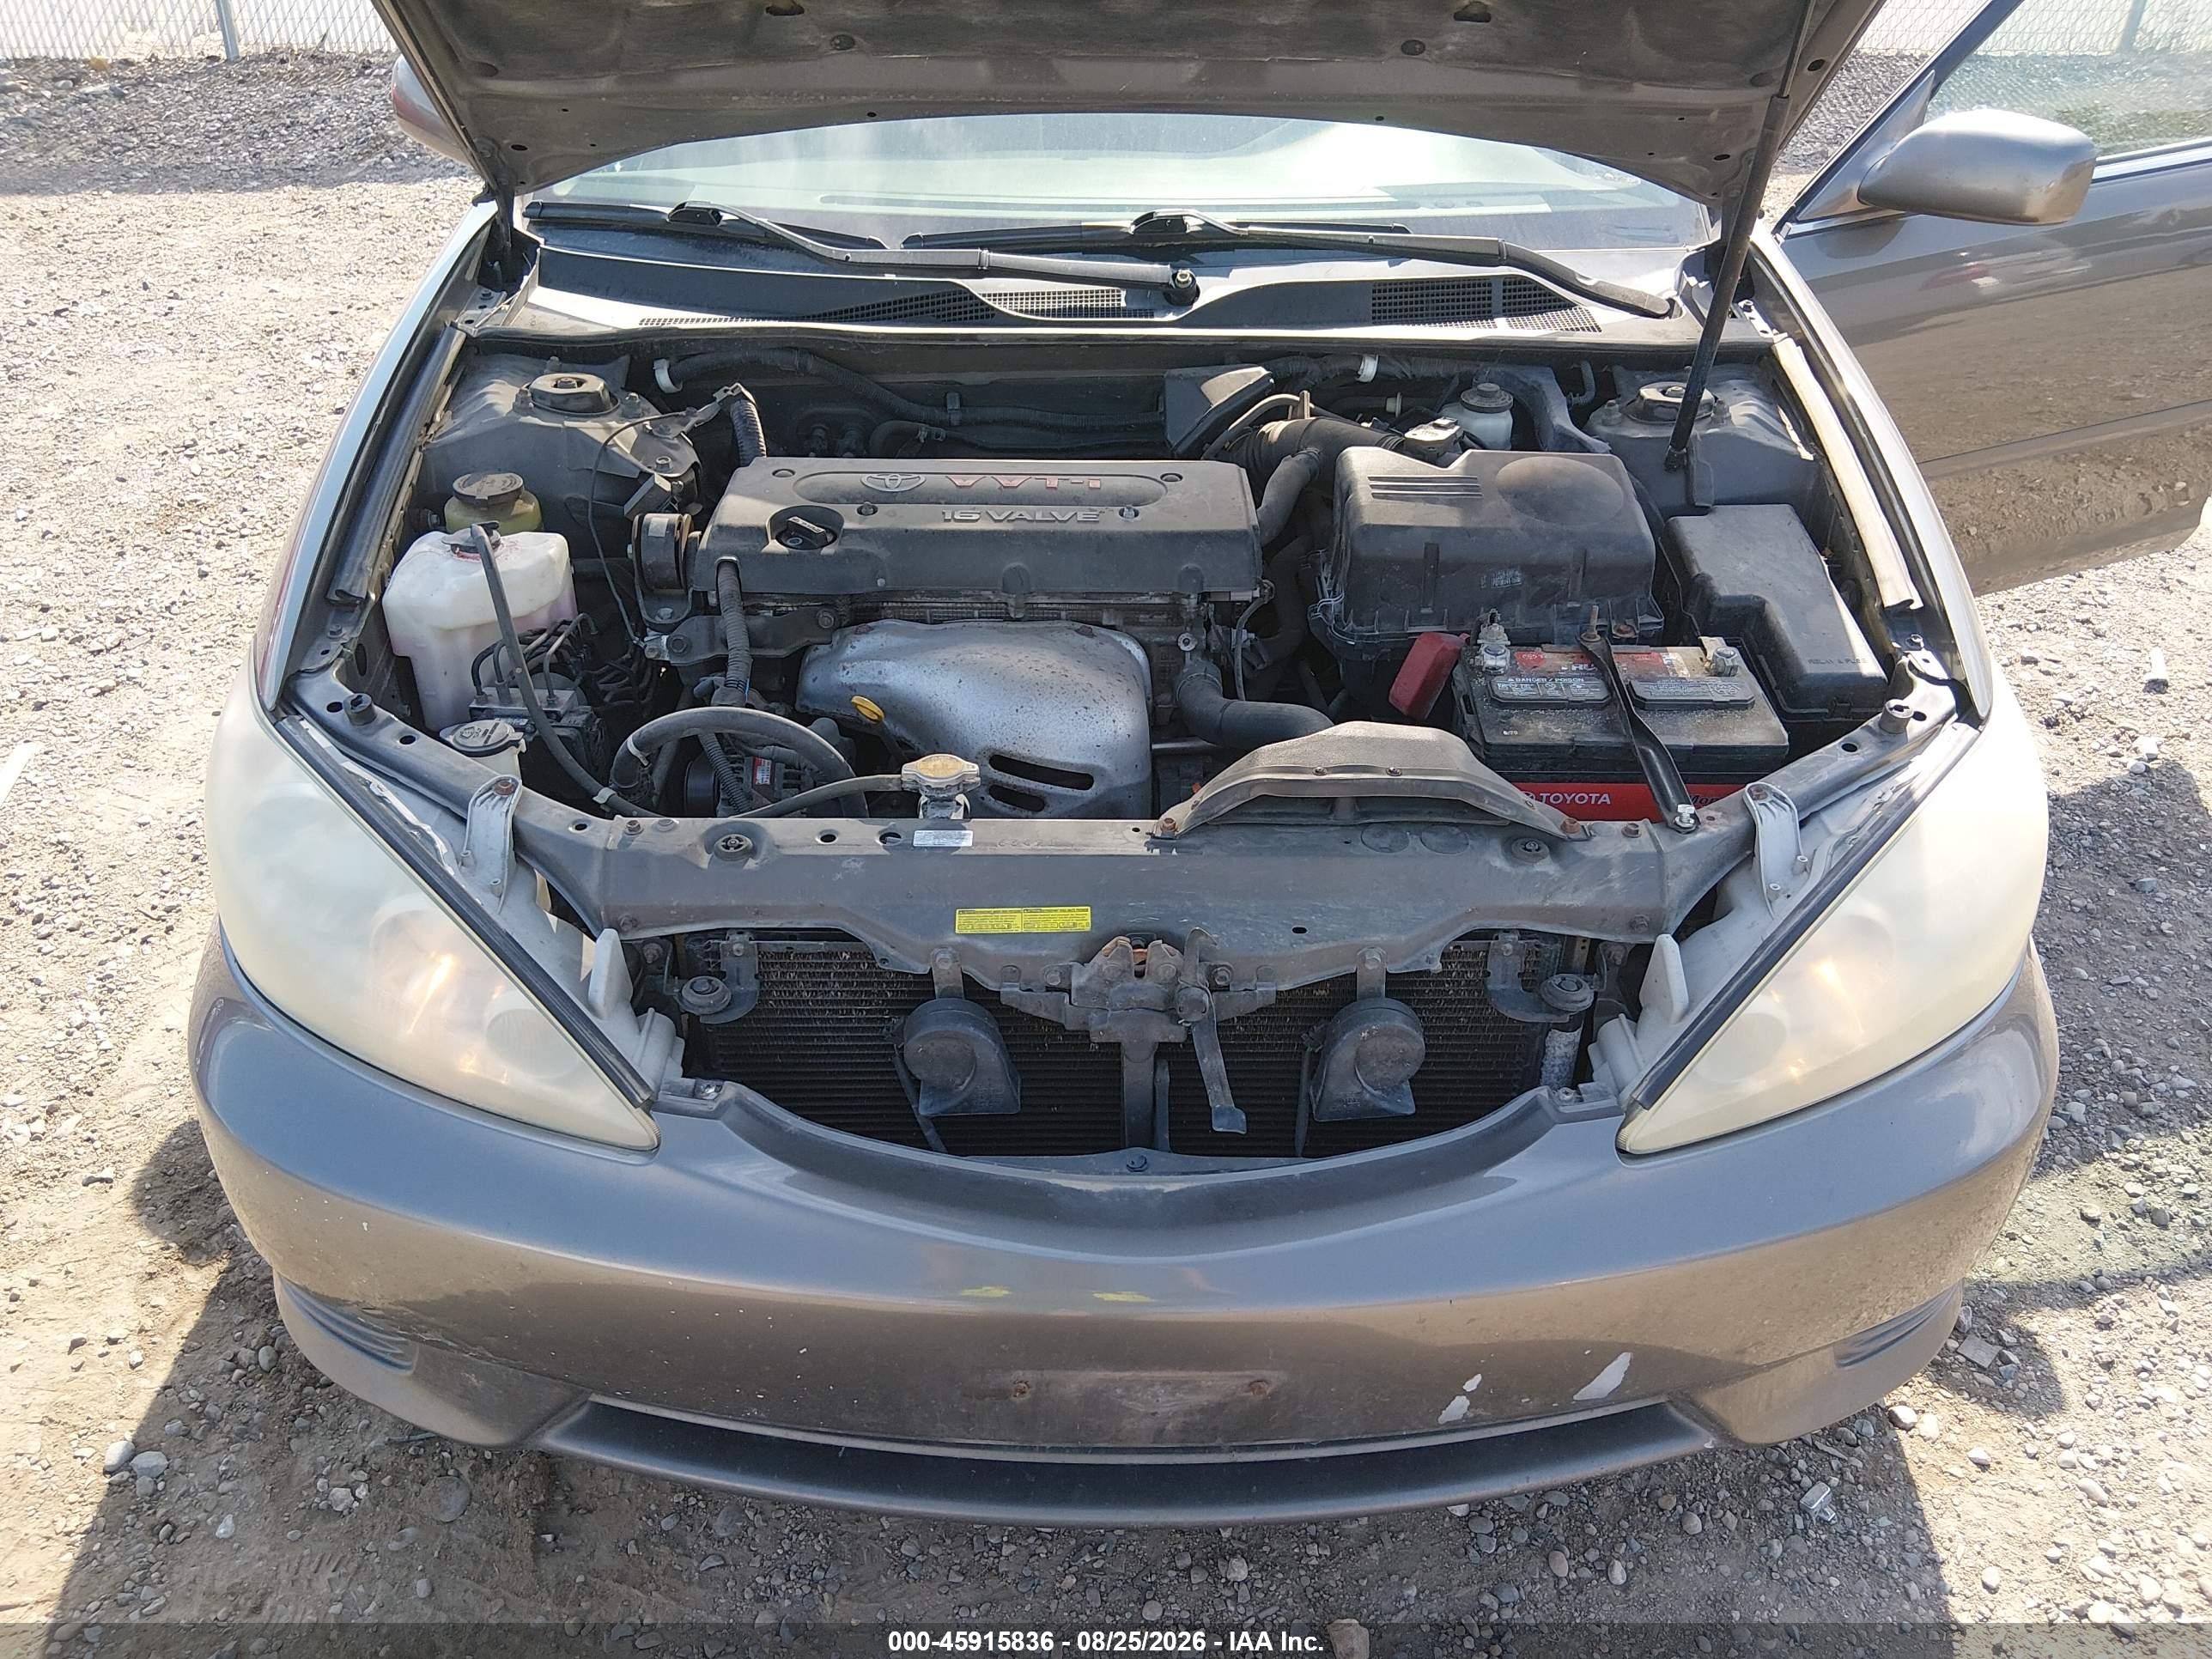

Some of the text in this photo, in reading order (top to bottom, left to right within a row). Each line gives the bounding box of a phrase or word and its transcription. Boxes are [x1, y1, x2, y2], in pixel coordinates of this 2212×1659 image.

[942, 509, 1101, 522] 16 VALVE
[1539, 793, 1612, 805] TOYOTA
